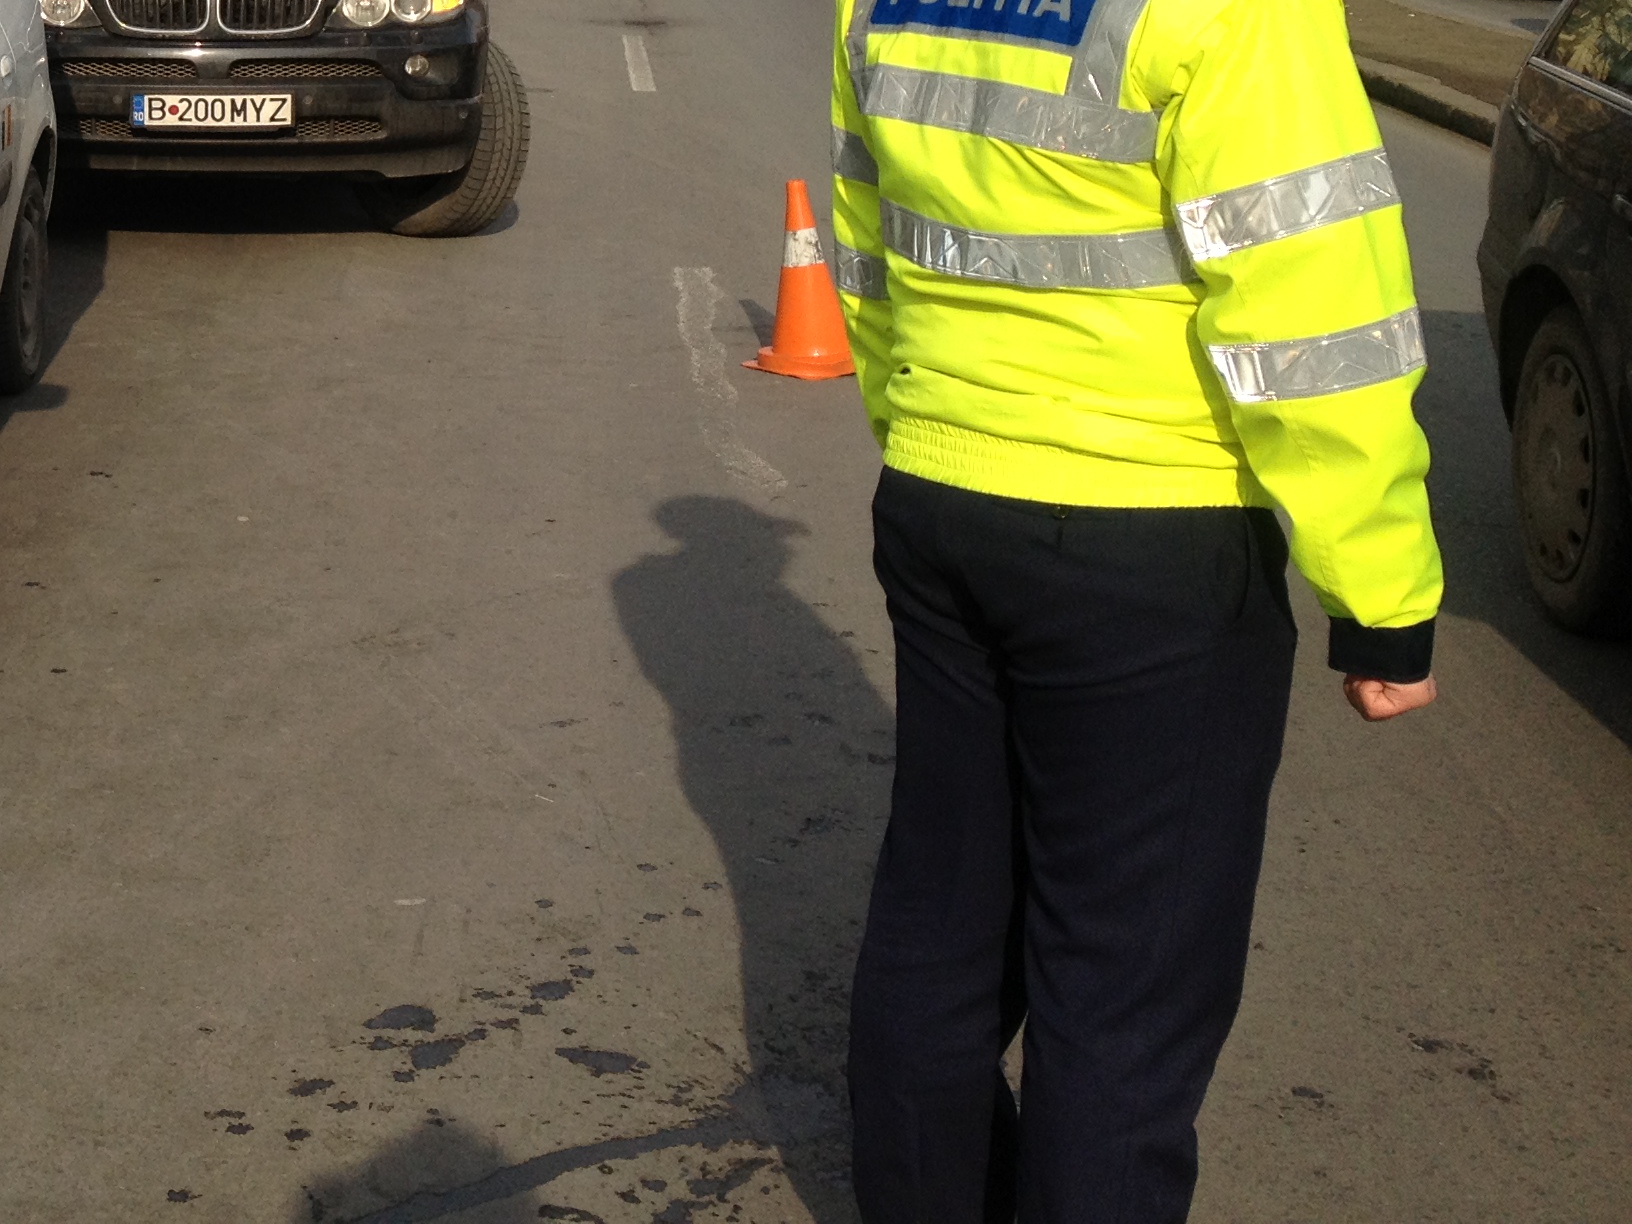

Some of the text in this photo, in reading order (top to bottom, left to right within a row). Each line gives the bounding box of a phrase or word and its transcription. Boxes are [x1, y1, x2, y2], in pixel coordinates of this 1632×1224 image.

[133, 97, 288, 123] RO B 200 MYZ
